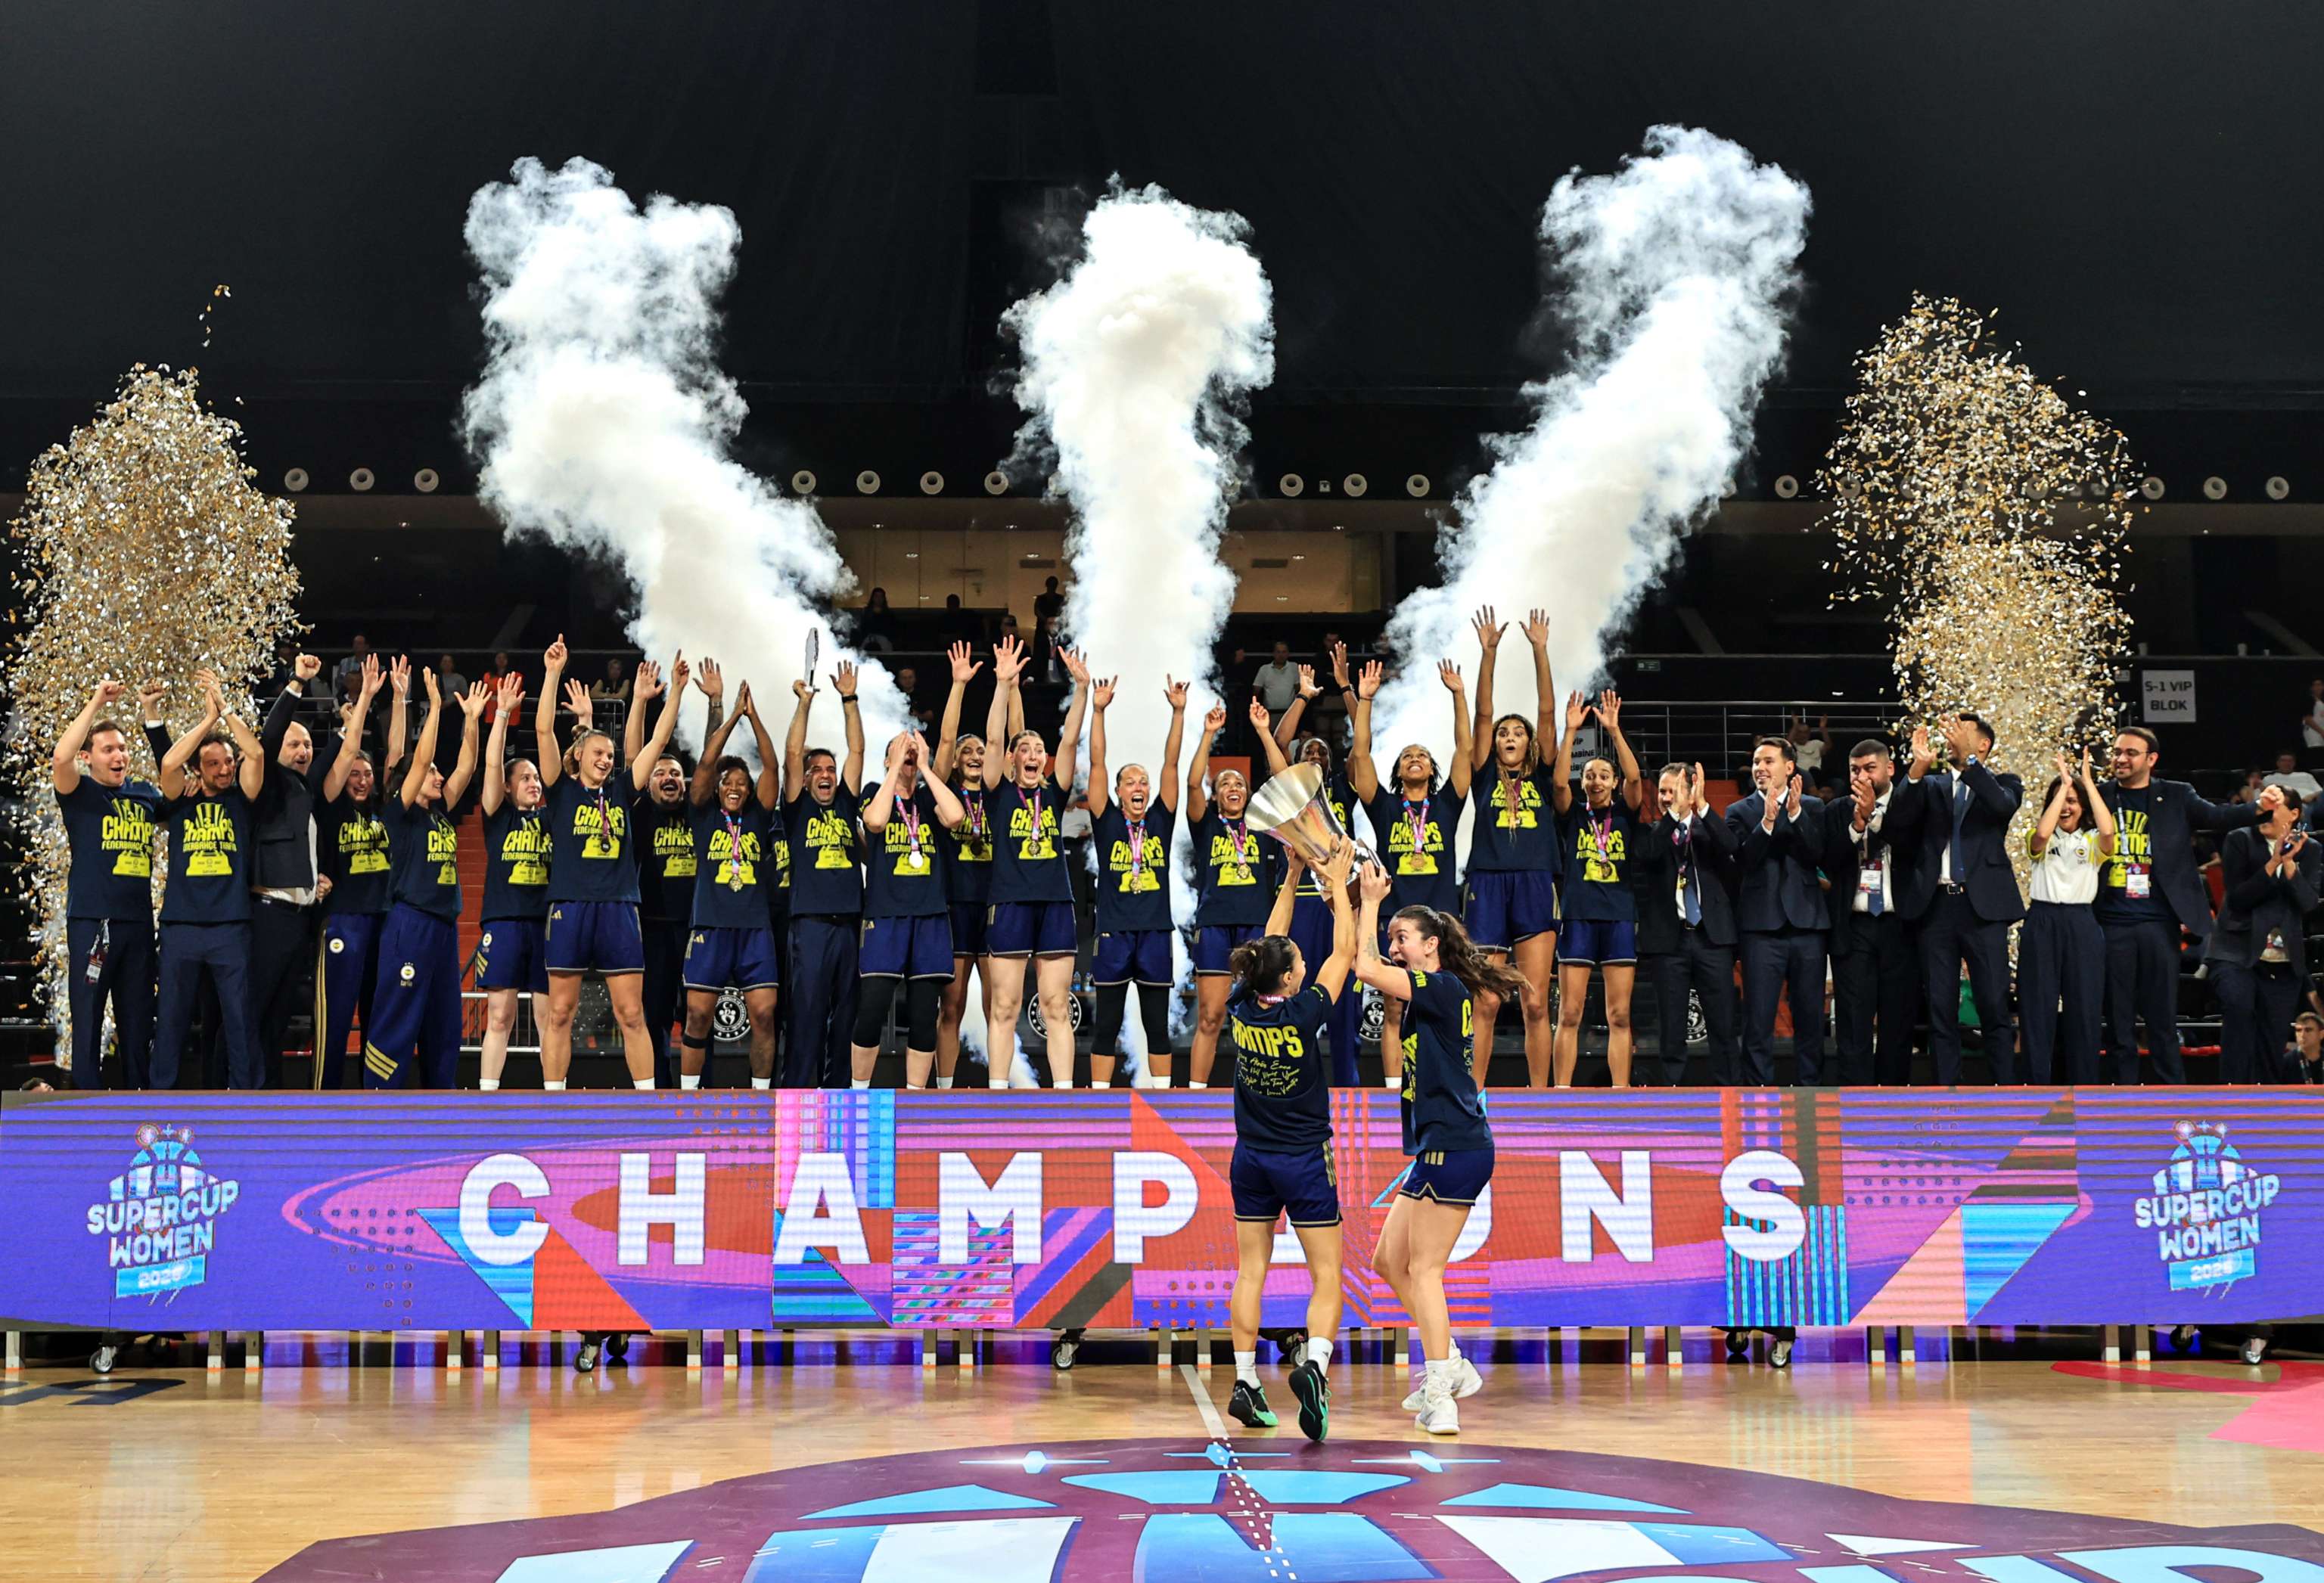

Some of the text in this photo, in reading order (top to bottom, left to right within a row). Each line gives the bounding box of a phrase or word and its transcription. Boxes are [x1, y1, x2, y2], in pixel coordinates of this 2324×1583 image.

[2150, 700, 2188, 710] BLOK
[102, 815, 154, 844] CHAMP
[1232, 1014, 1304, 1058] HAMPS
[87, 1180, 241, 1235] SUPERCUP
[2135, 1175, 2280, 1228] SUPERCUP
[110, 1218, 215, 1268] WOMEN
[2158, 1212, 2262, 1262] WOMEN
